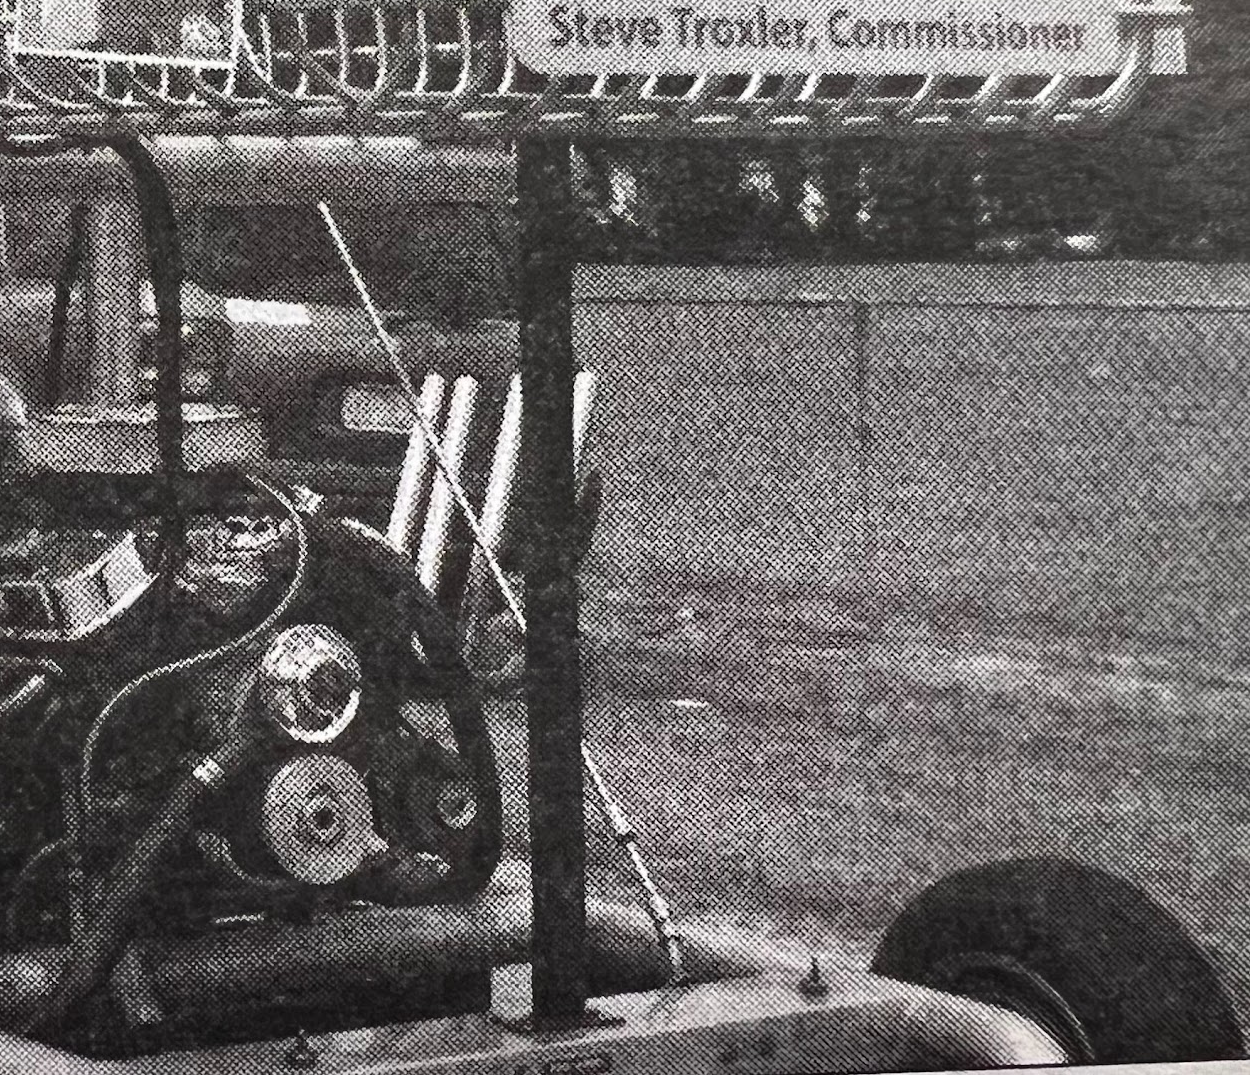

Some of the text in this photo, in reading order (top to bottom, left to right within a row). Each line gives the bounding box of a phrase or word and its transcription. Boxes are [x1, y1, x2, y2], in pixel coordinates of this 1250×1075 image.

[549, 3, 1087, 56] Steve Troxler, Commissioner
